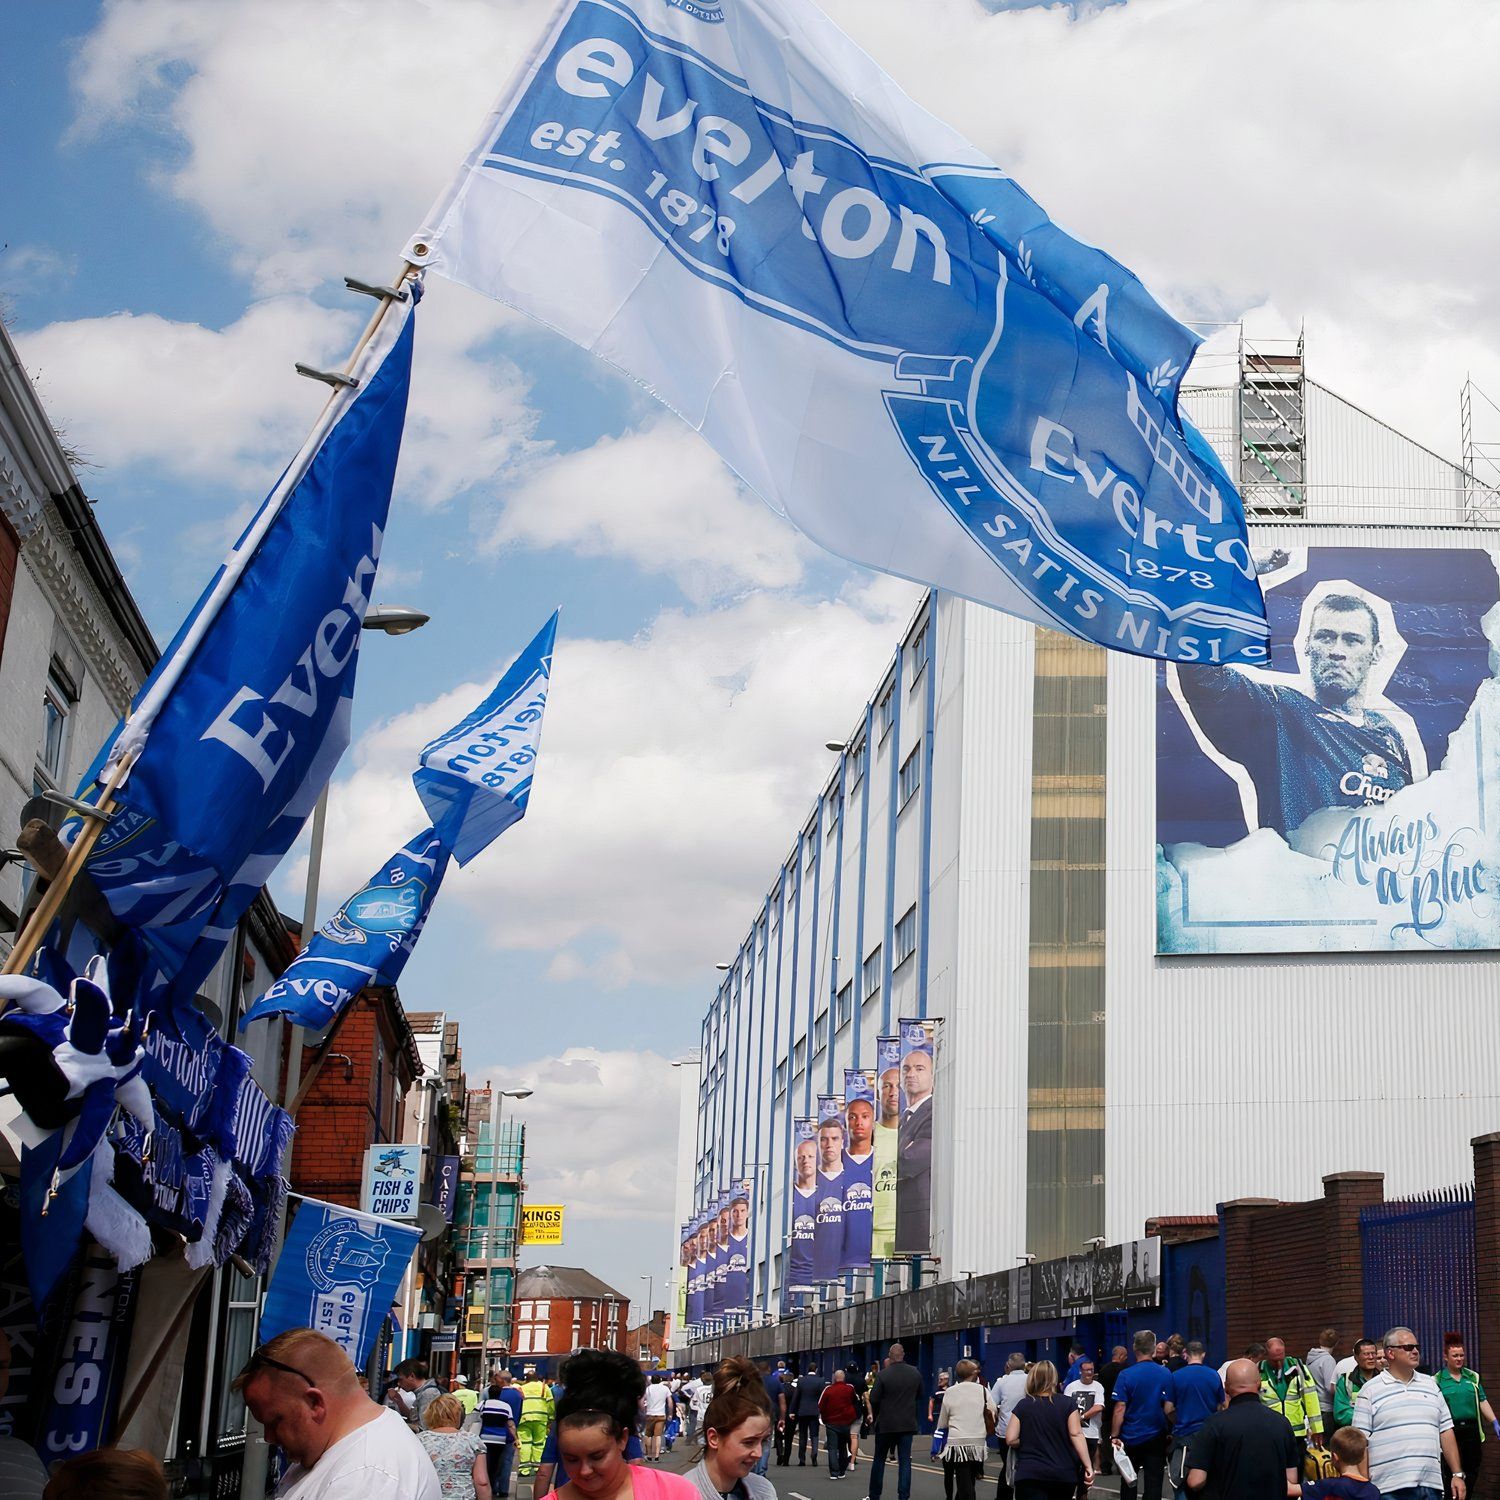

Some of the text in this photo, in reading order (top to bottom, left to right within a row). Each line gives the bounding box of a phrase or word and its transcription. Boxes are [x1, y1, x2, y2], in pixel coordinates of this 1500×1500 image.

[530, 121, 737, 257] est. 1878
[1029, 416, 1257, 581] Everto
[918, 434, 1222, 663] NIL SATIS NISI
[1117, 548, 1216, 590] 1878
[1376, 832, 1489, 943] a Blue
[373, 1181, 414, 1195] FISH &
[373, 1199, 410, 1213] CHIPS
[523, 1211, 561, 1222] KINGS
